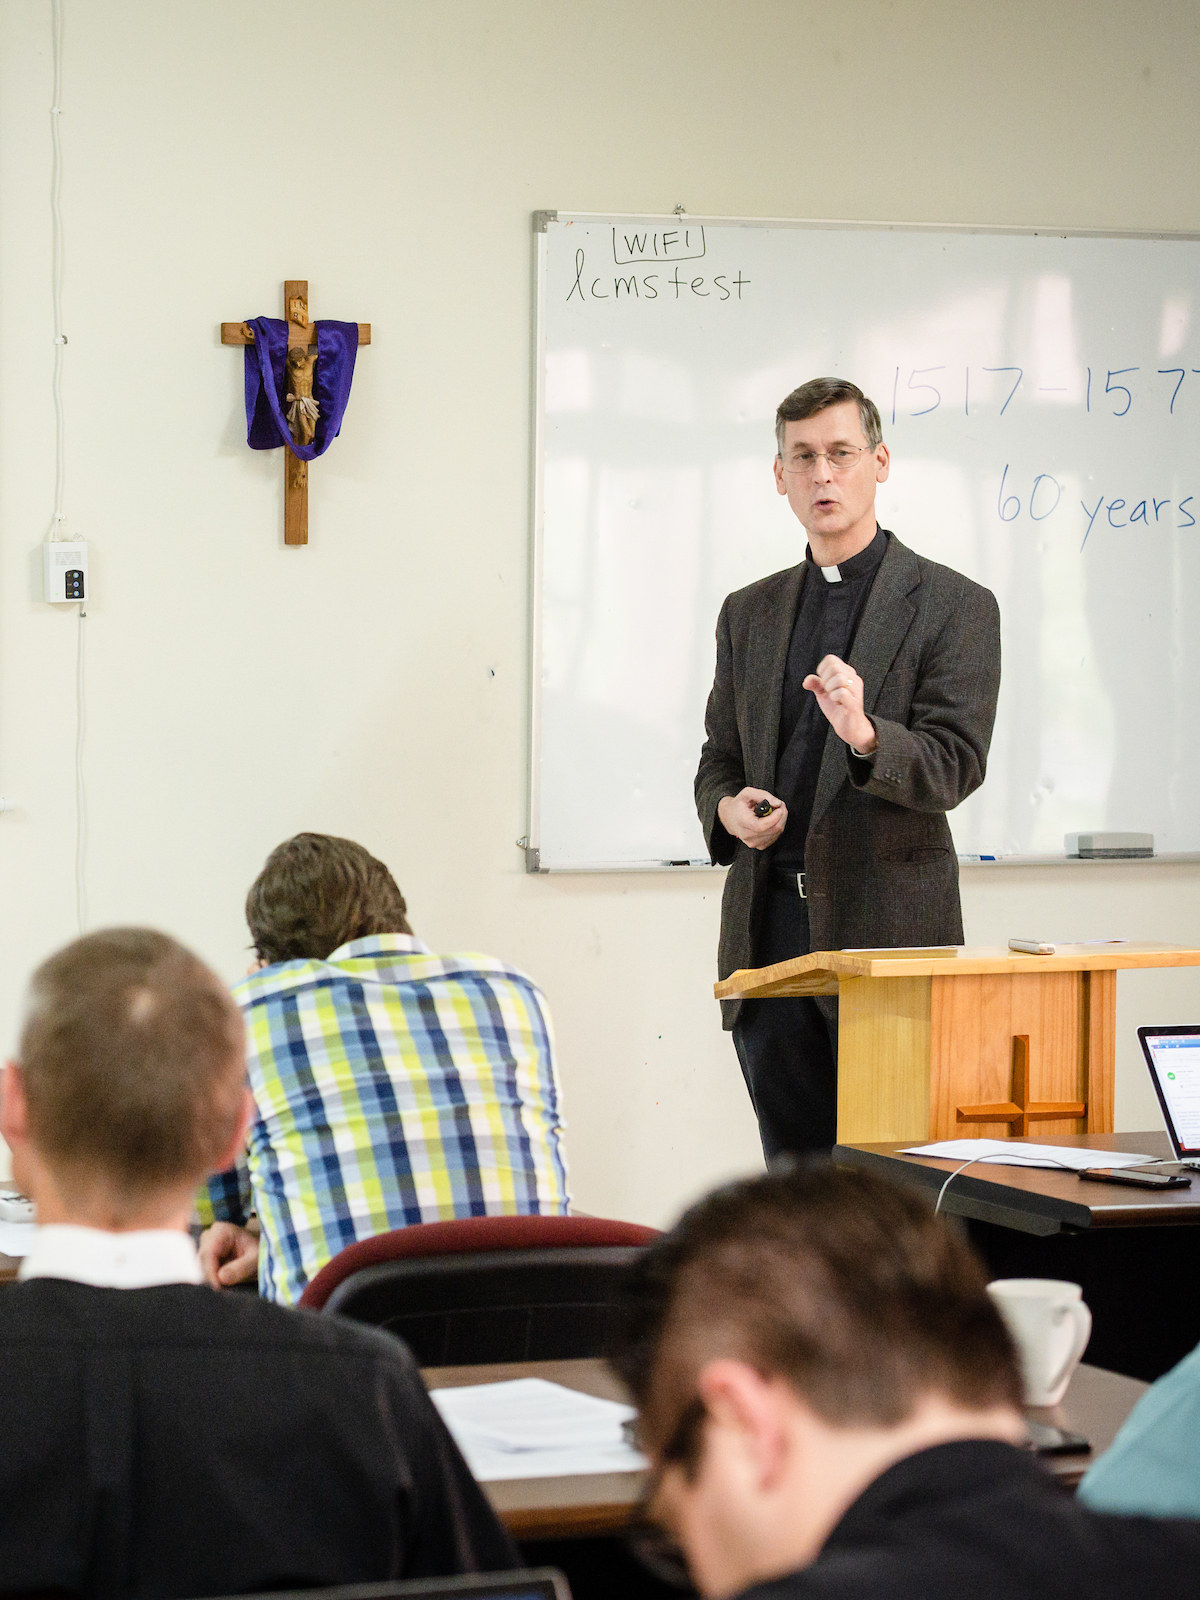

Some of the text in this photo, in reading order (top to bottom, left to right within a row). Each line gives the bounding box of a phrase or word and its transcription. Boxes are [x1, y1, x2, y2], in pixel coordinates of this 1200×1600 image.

[624, 230, 689, 256] WIFI
[998, 464, 1196, 554] 60 years
